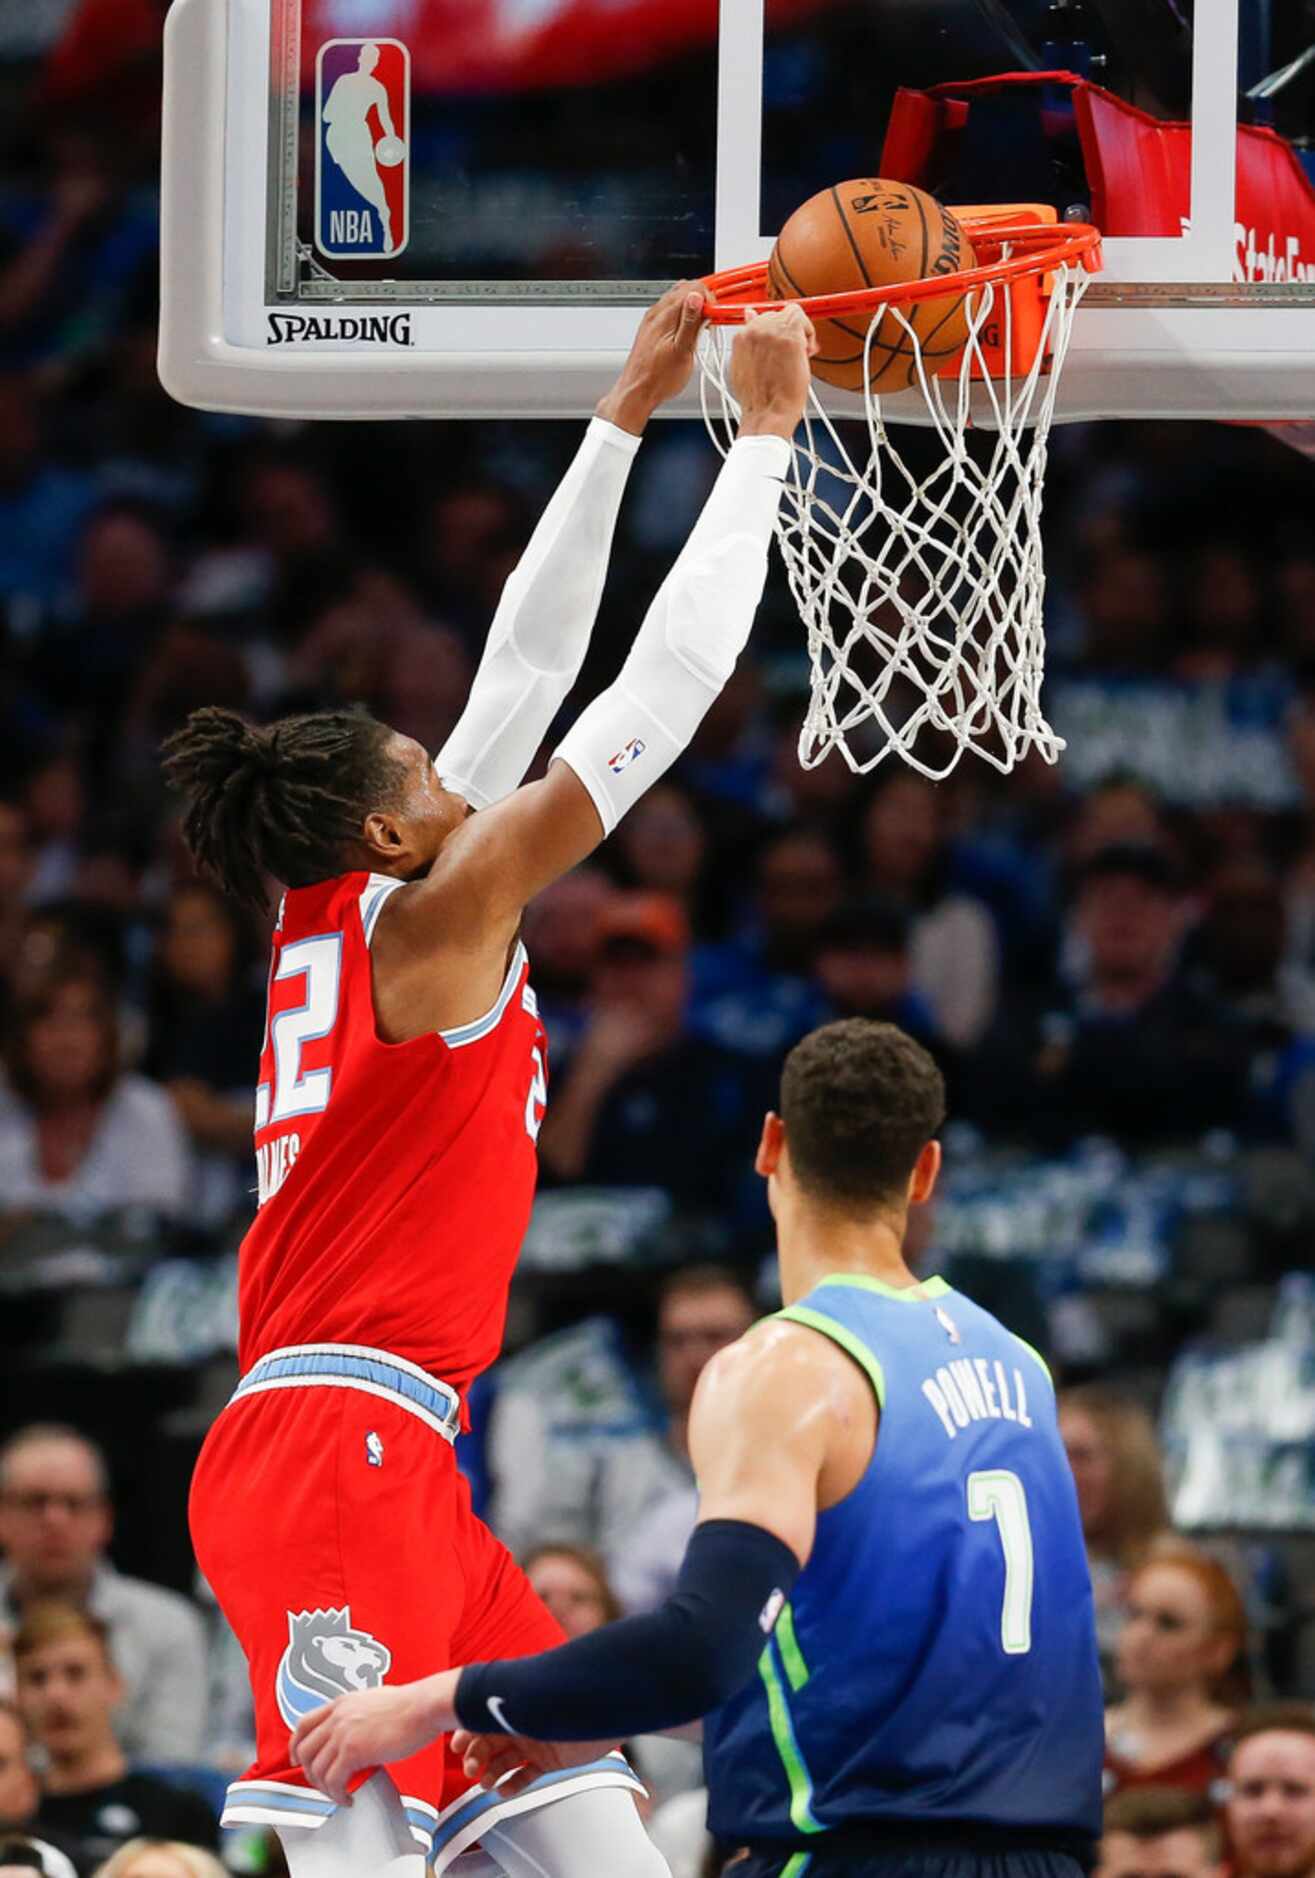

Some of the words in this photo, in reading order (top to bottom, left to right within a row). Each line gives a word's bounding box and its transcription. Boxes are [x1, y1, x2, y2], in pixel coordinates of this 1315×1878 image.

[330, 210, 373, 244] NBA
[267, 313, 412, 346] SPALDING
[921, 1357, 1032, 1439] POWELL
[967, 1469, 1034, 1655] 7
